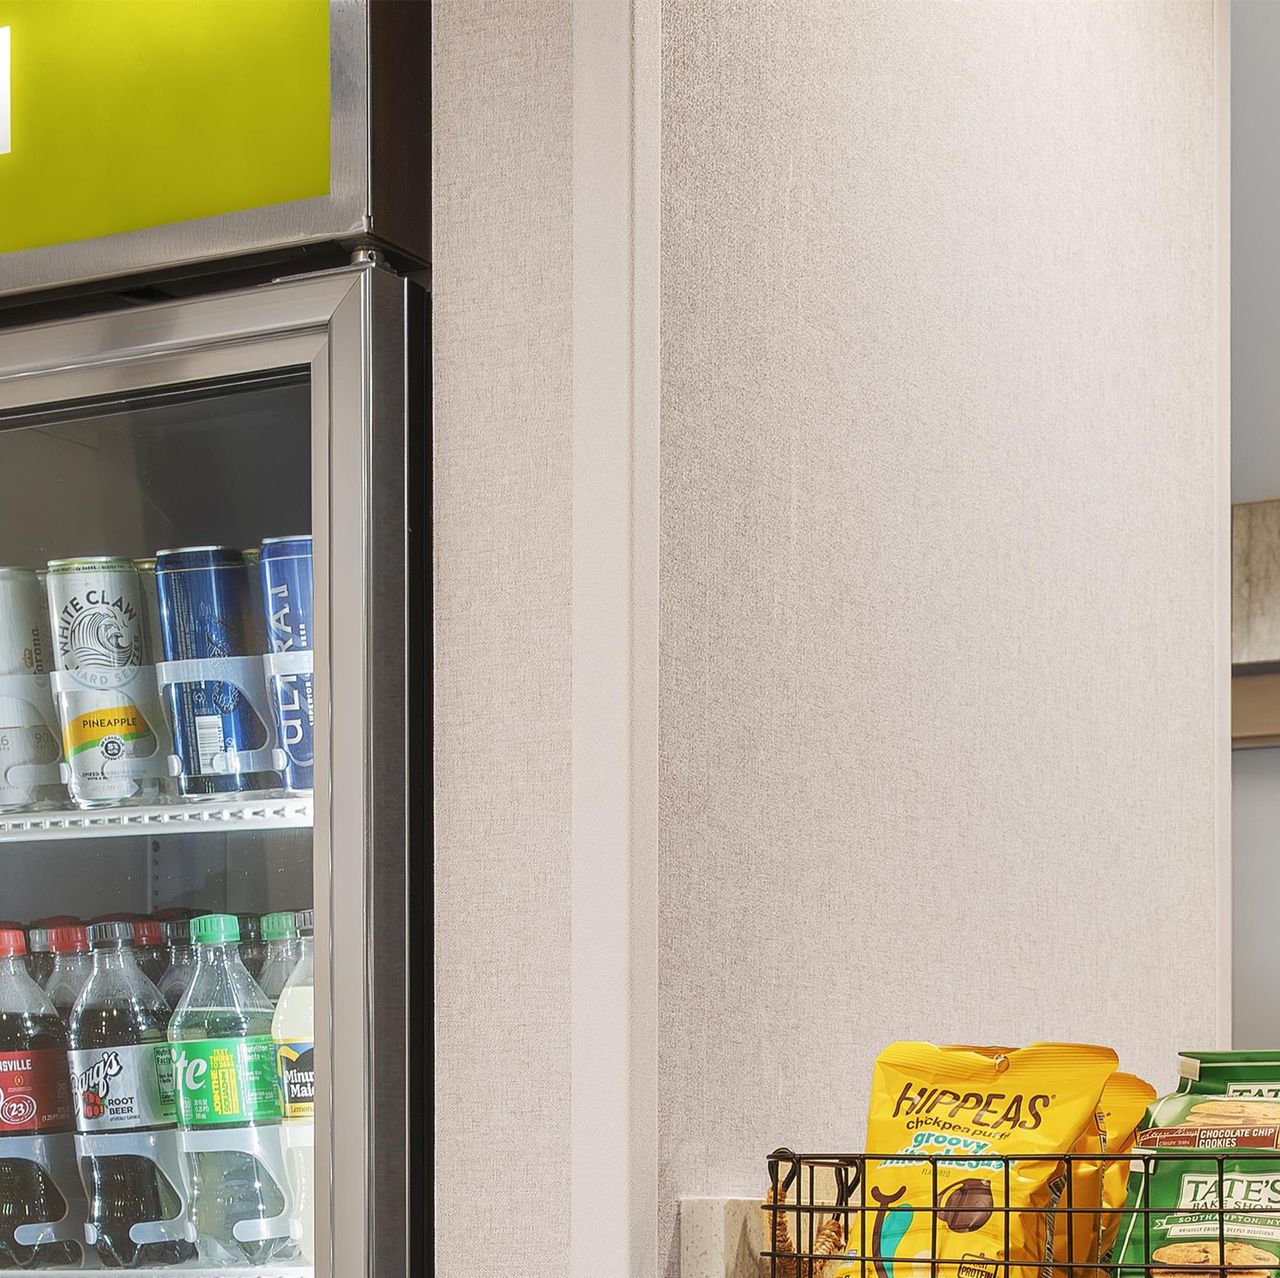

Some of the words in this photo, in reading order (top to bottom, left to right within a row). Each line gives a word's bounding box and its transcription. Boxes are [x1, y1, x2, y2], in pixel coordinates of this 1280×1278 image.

[60, 597, 82, 658] WHITE
[85, 590, 137, 622] CLAW
[82, 717, 137, 729] PINEAPPLE
[109, 1097, 134, 1107] ROOT
[893, 1082, 1049, 1130] HIPPEAS
[10, 1102, 25, 1116] 23
[109, 1106, 133, 1115] BEER
[1200, 1128, 1251, 1139] CHOCOLATE
[1252, 1127, 1274, 1137] CHIP
[913, 1130, 988, 1154] groovy
[1200, 1138, 1236, 1148] COOKIES
